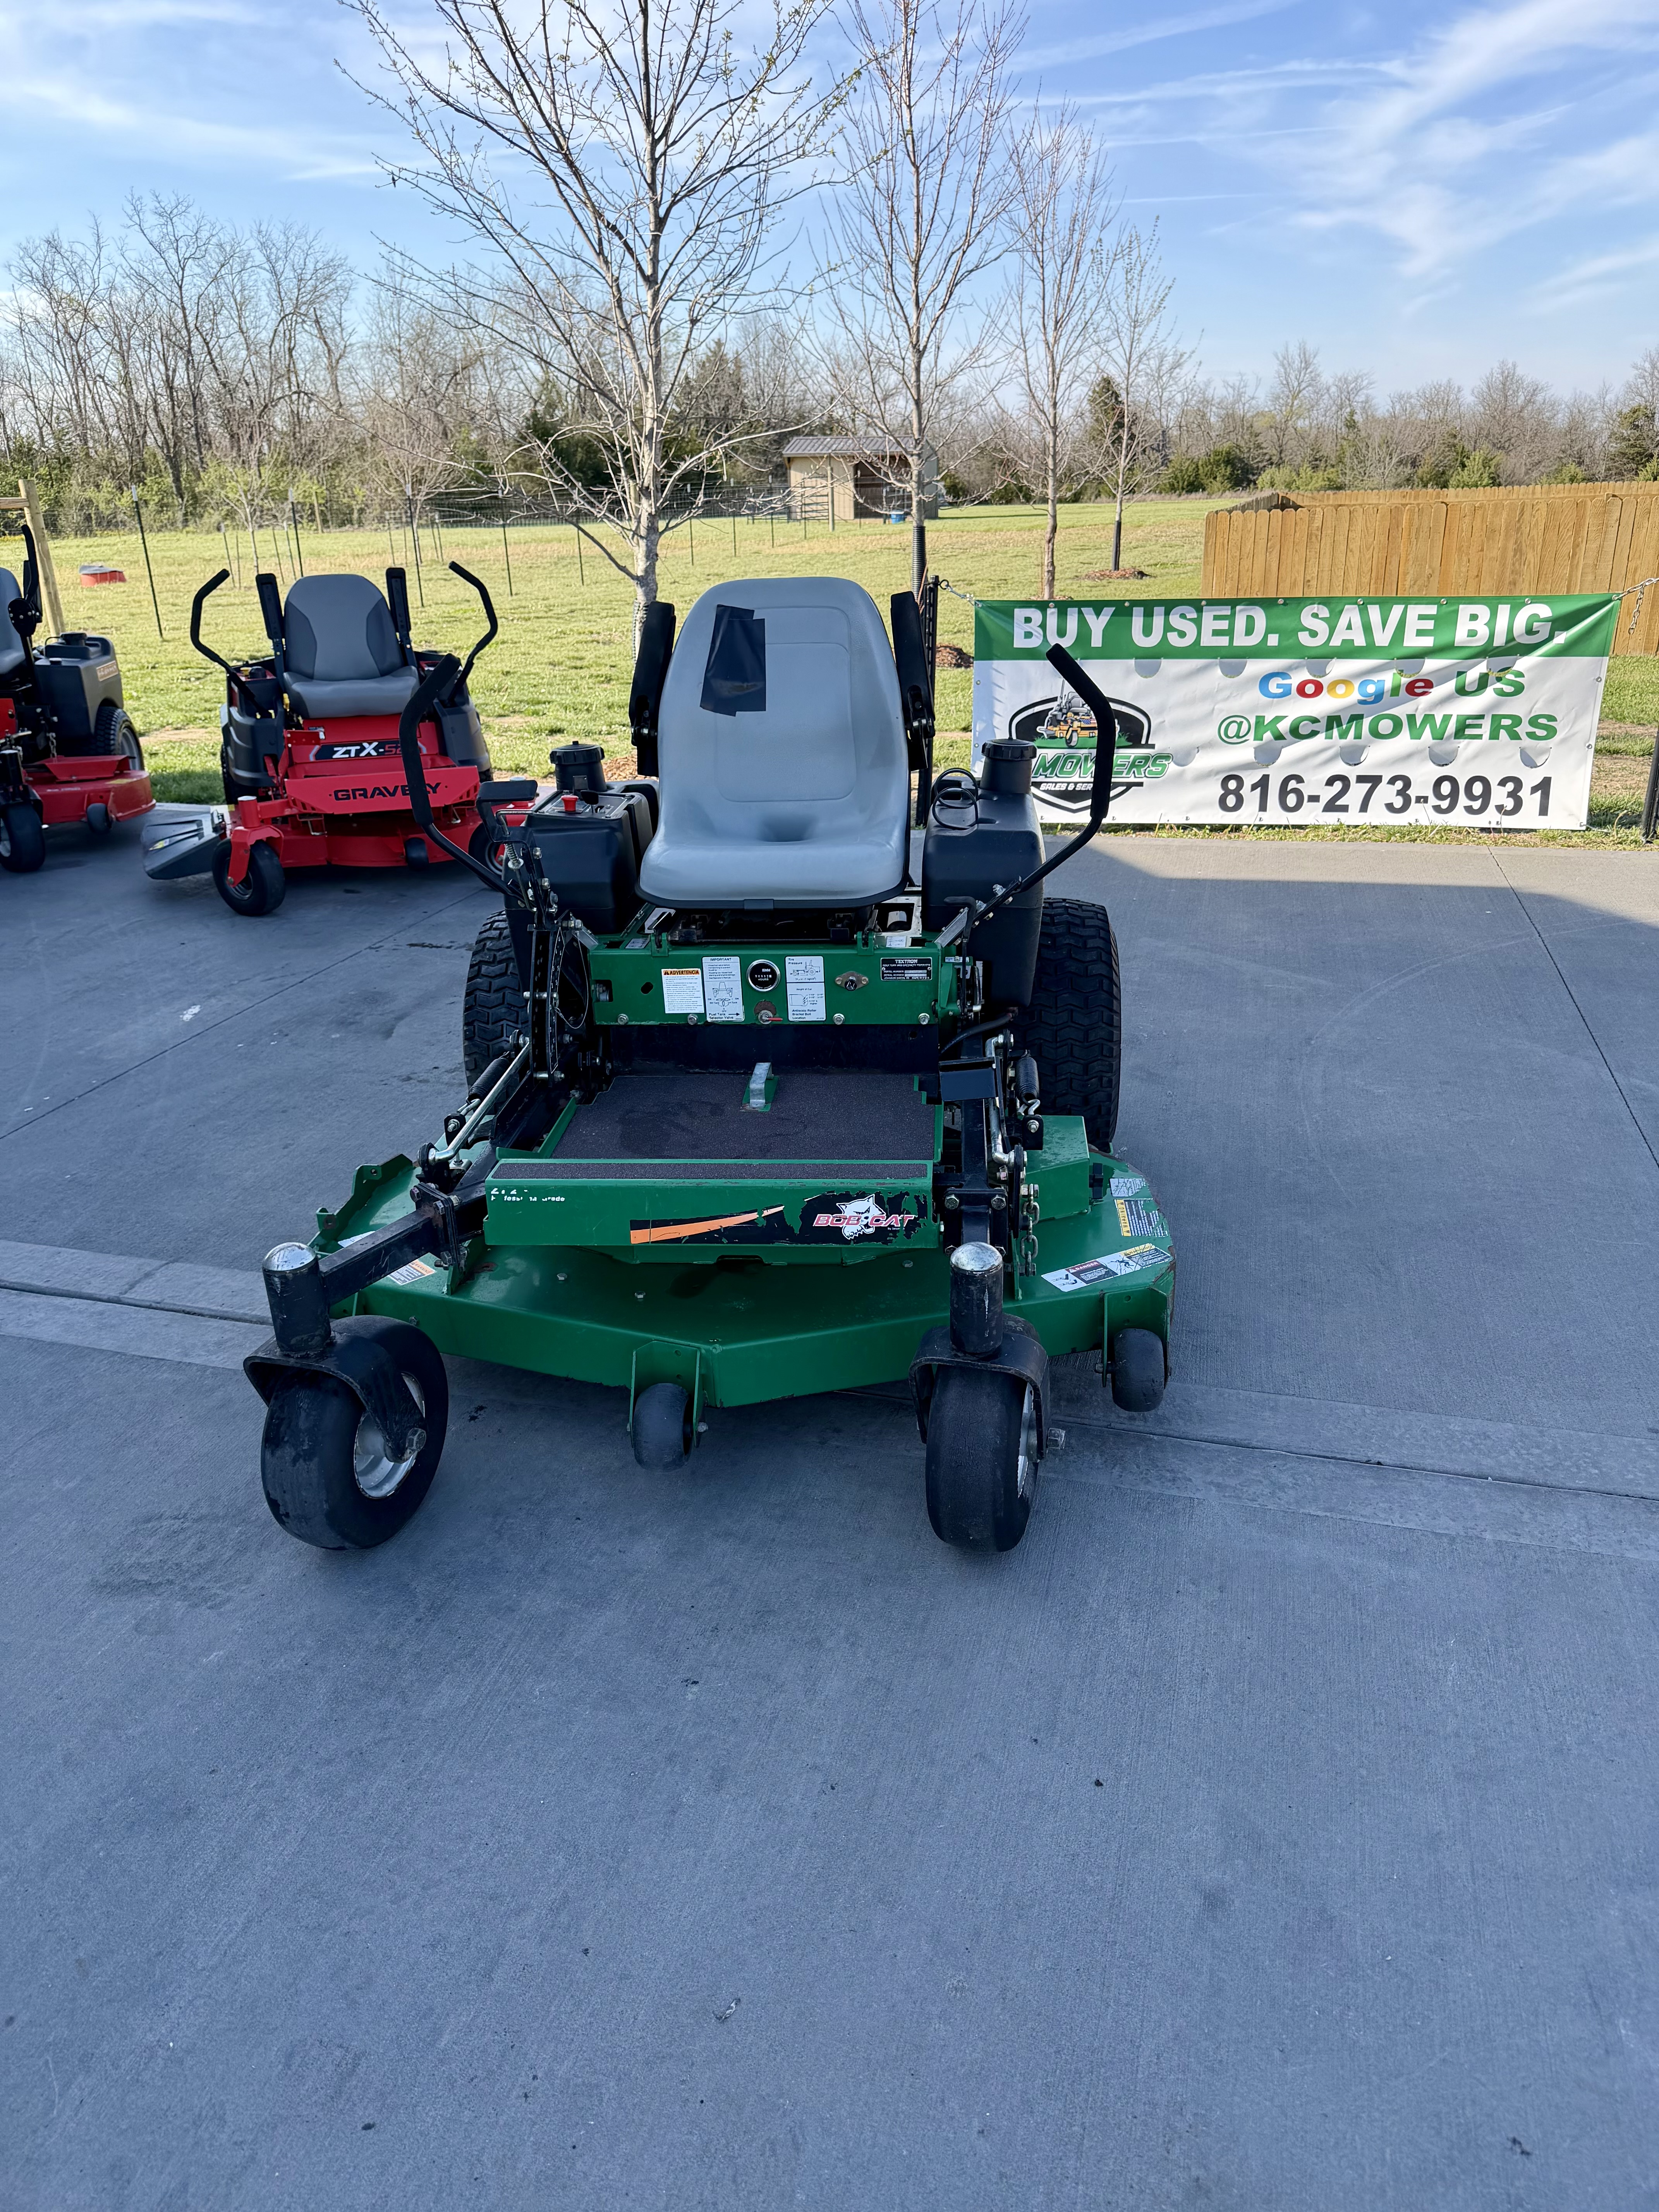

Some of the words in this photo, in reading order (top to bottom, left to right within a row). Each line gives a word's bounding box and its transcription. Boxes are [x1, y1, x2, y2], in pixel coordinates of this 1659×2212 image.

[1013, 607, 1115, 648] BUY
[1131, 605, 1279, 647] USED.
[1297, 604, 1437, 647] SAVE
[1454, 603, 1567, 647] BIG.
[1258, 669, 1434, 705] Google
[1454, 667, 1525, 698] US
[1218, 713, 1558, 745] @KCMOWERS
[333, 782, 441, 801] GRAVEY
[1218, 774, 1552, 817] 816-273-9931
[813, 1214, 862, 1227] BOB
[1075, 1262, 1099, 1270] DANGER
